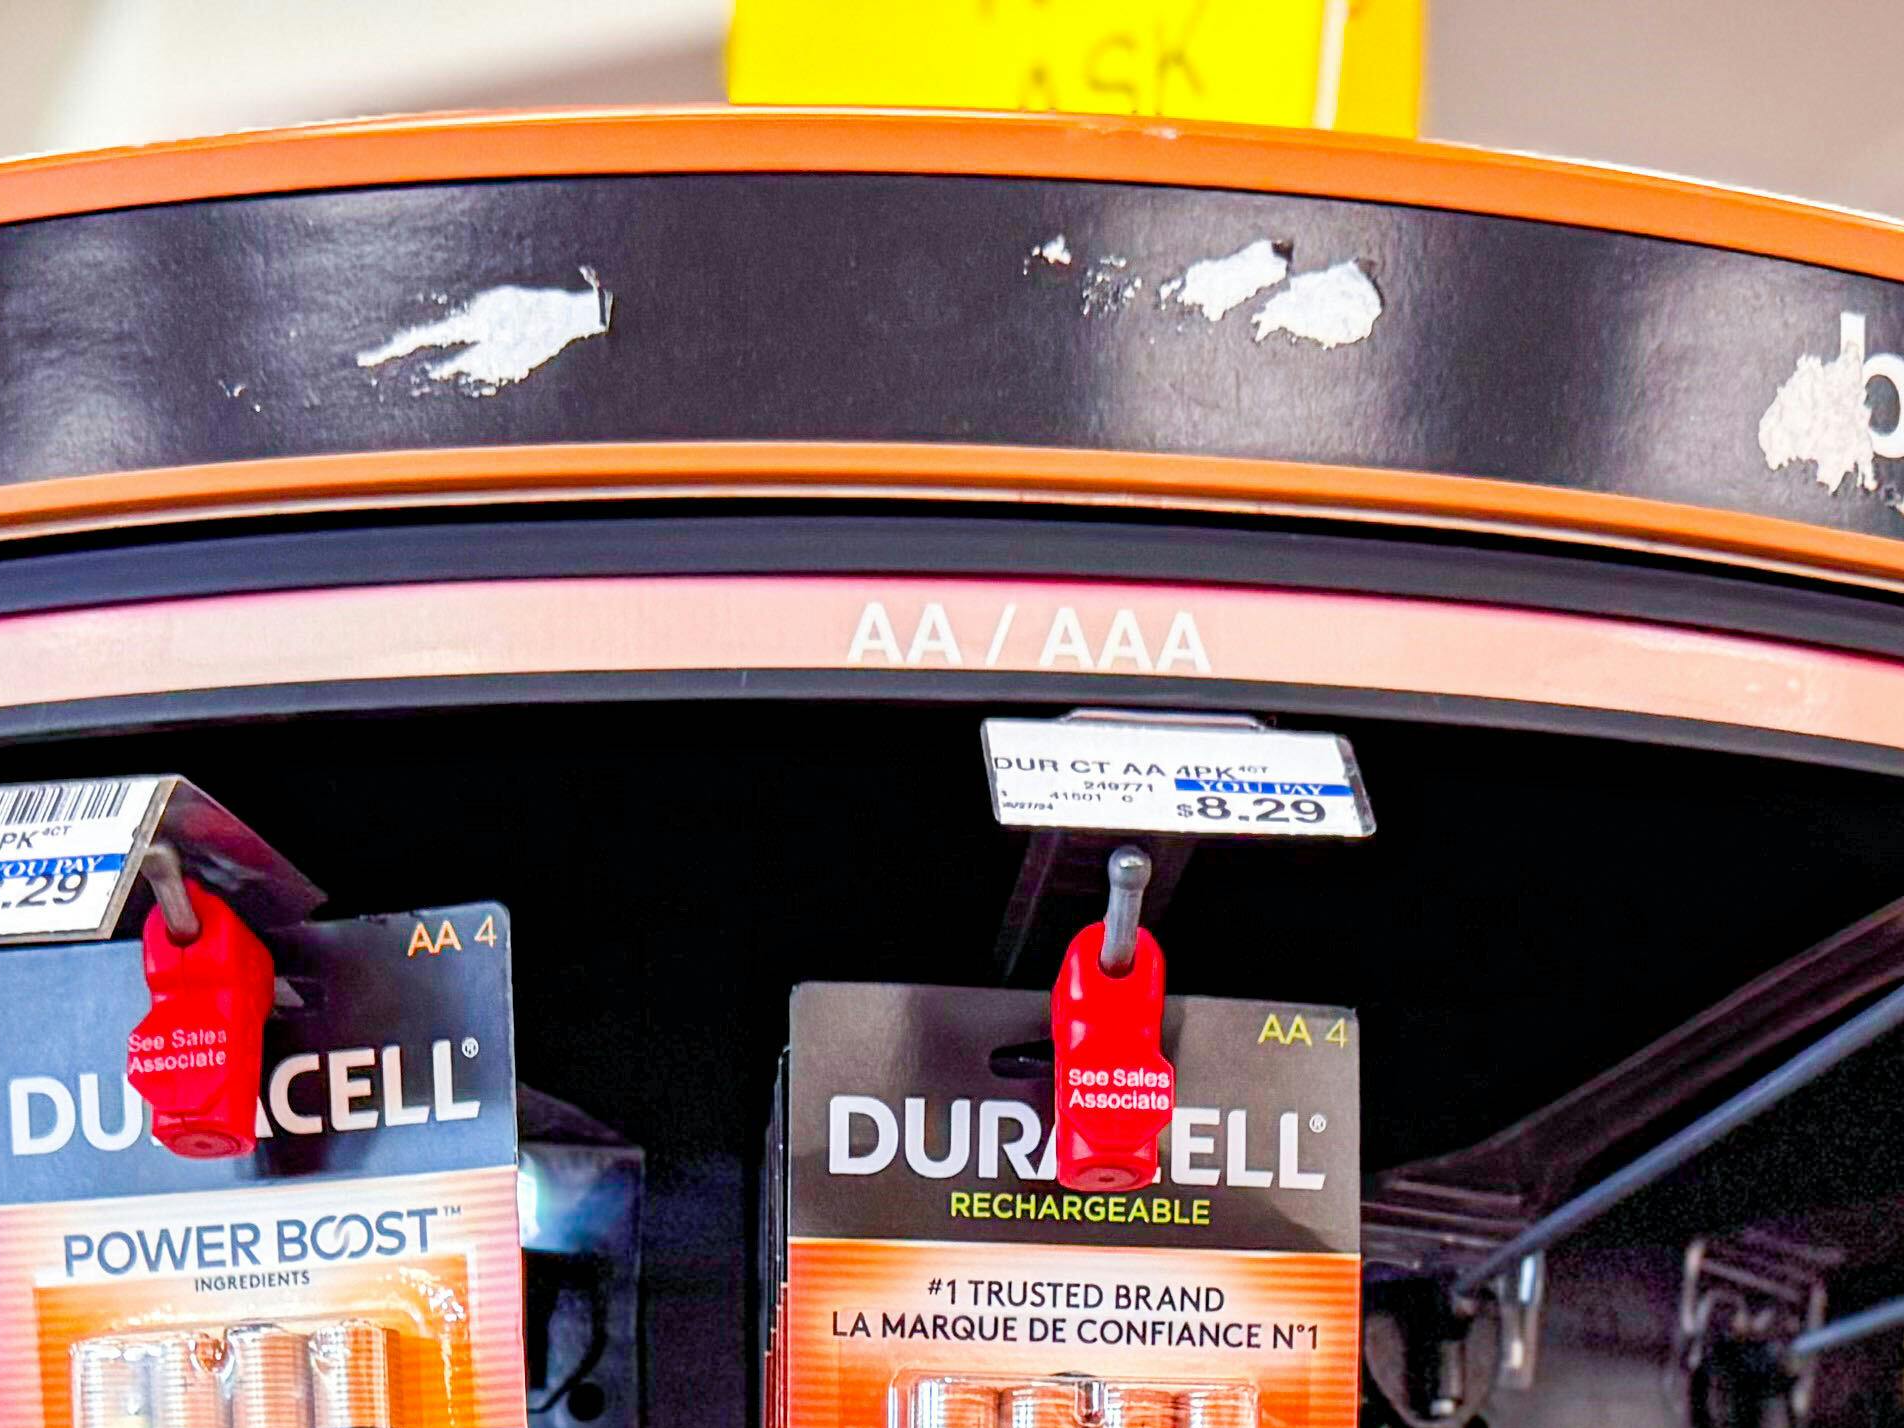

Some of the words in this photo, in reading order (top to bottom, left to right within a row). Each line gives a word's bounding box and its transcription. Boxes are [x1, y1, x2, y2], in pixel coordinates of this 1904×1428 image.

[848, 602, 962, 666] AA
[1039, 607, 1212, 673] AAA
[1070, 760, 1110, 774] CT
[1123, 763, 1166, 777] AA
[1176, 766, 1237, 780] 4PK
[1176, 796, 1326, 824] $8.29
[407, 920, 462, 956] AA
[475, 917, 497, 948] 4
[1258, 1014, 1312, 1046] AA
[1326, 1016, 1347, 1048] 4
[1068, 1068, 1108, 1088] See
[1112, 1068, 1170, 1089] Sales
[9, 1039, 480, 1157] DUCELL
[1068, 1090, 1170, 1110] Associate
[828, 1094, 1326, 1191] DURELL
[950, 1192, 1210, 1225] RECHARGEABLE
[64, 1222, 261, 1278] POWER
[277, 1208, 439, 1263] BOOST
[194, 1271, 310, 1293] INGREDIENTS
[928, 1278, 958, 1306] #1
[968, 1280, 1104, 1310] TRUSTED
[1115, 1285, 1224, 1313] BRAND
[832, 1311, 871, 1340] LA
[881, 1314, 1018, 1344] MARQUE
[1030, 1319, 1066, 1344] DE
[1077, 1320, 1261, 1348] CONFIANCE
